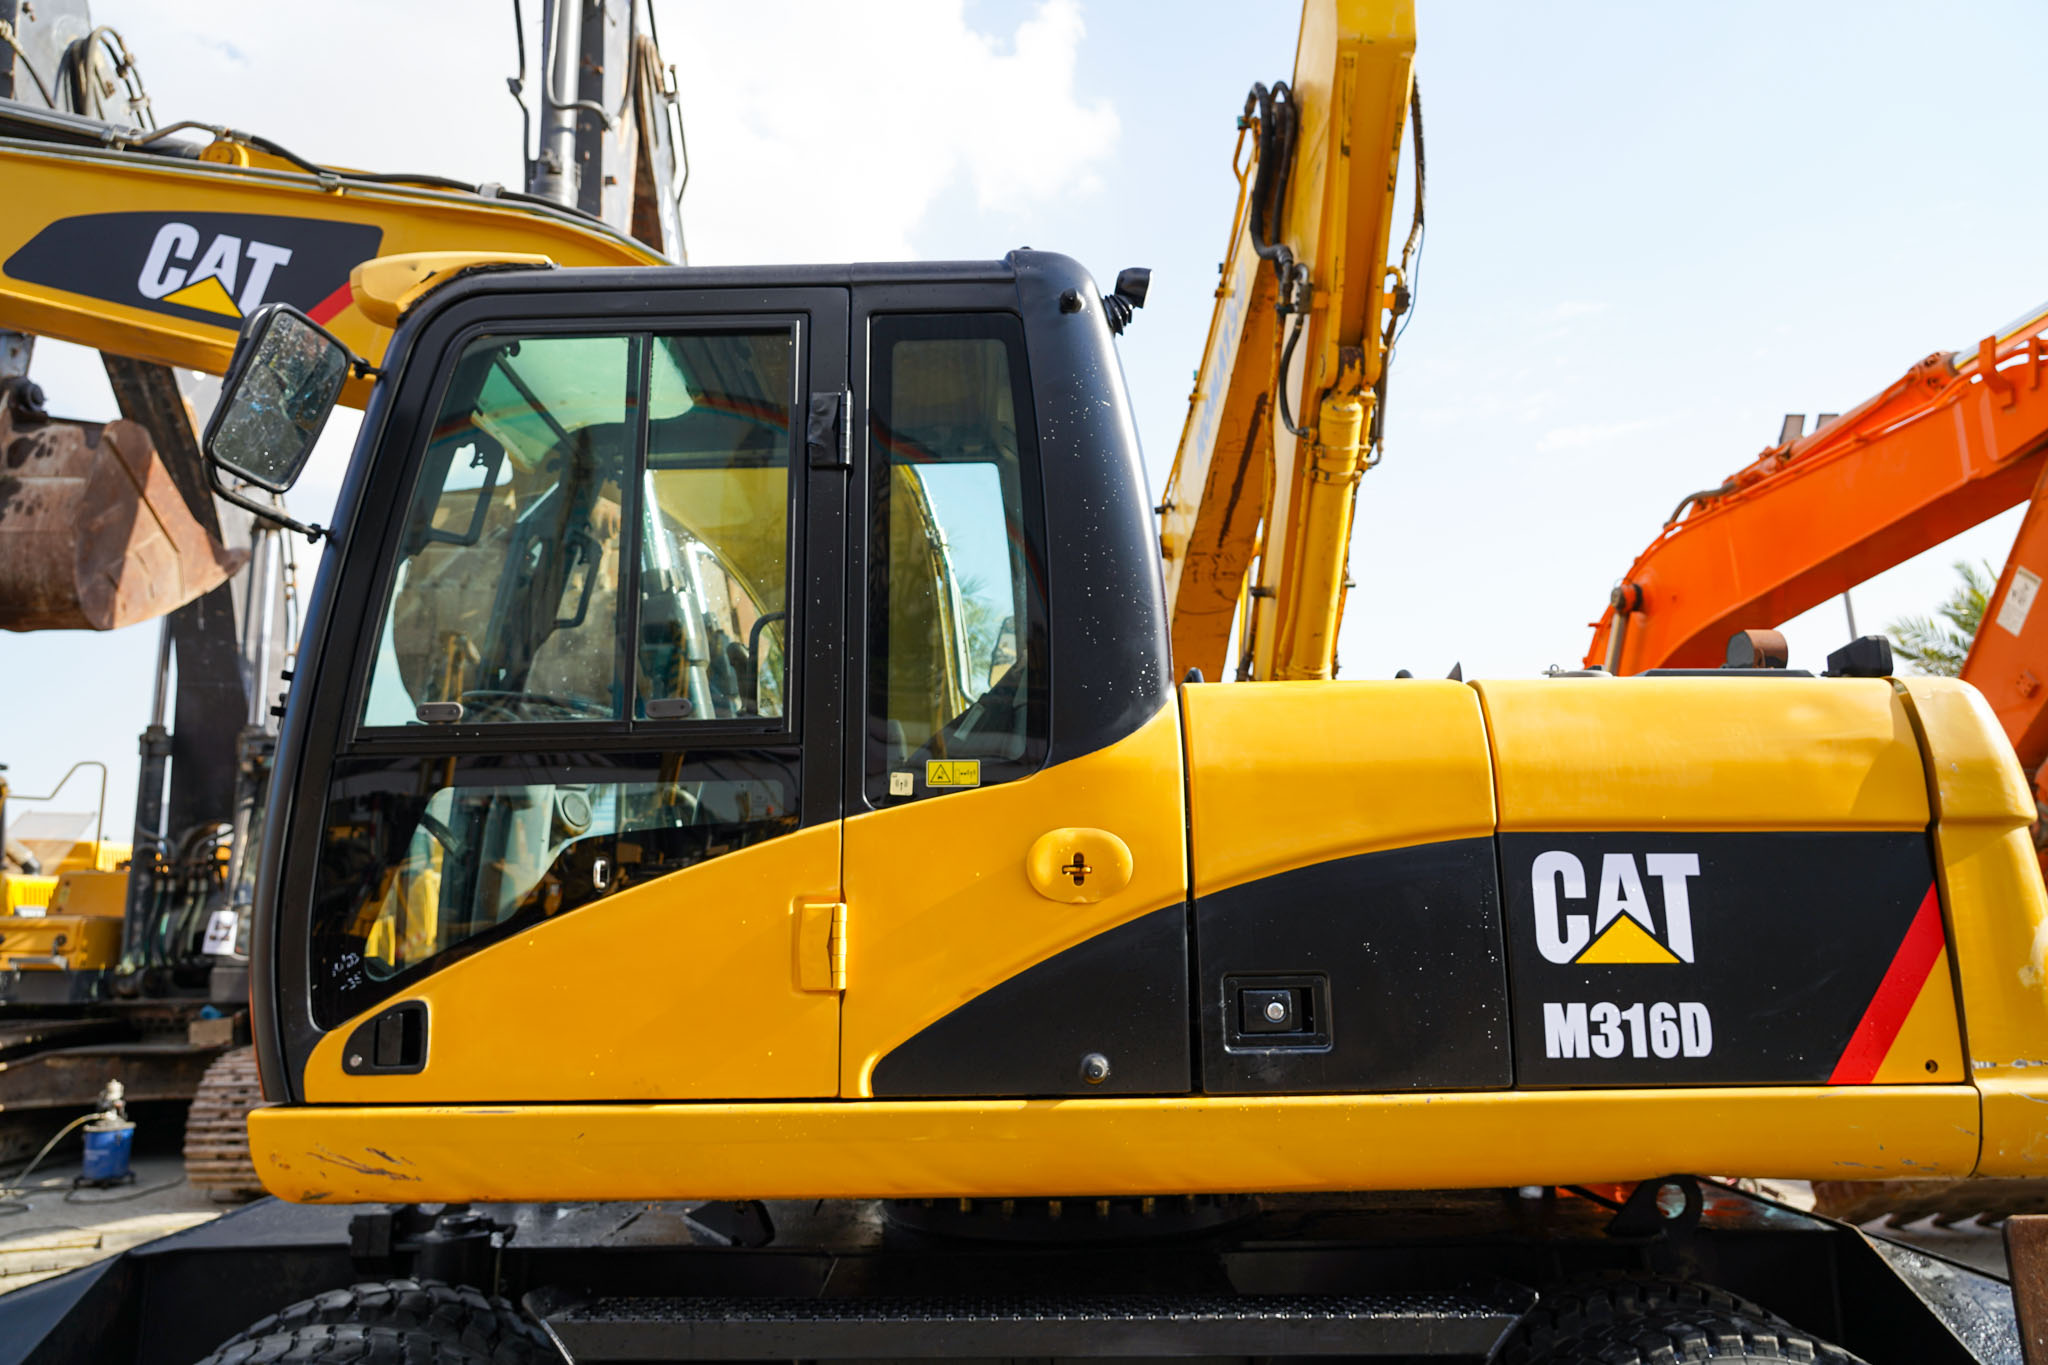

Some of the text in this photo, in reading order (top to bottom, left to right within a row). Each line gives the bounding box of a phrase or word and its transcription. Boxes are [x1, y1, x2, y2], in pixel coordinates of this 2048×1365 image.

[138, 223, 292, 317] CAT
[1531, 850, 1700, 964] CAT
[1543, 1001, 1713, 1059] M316D
